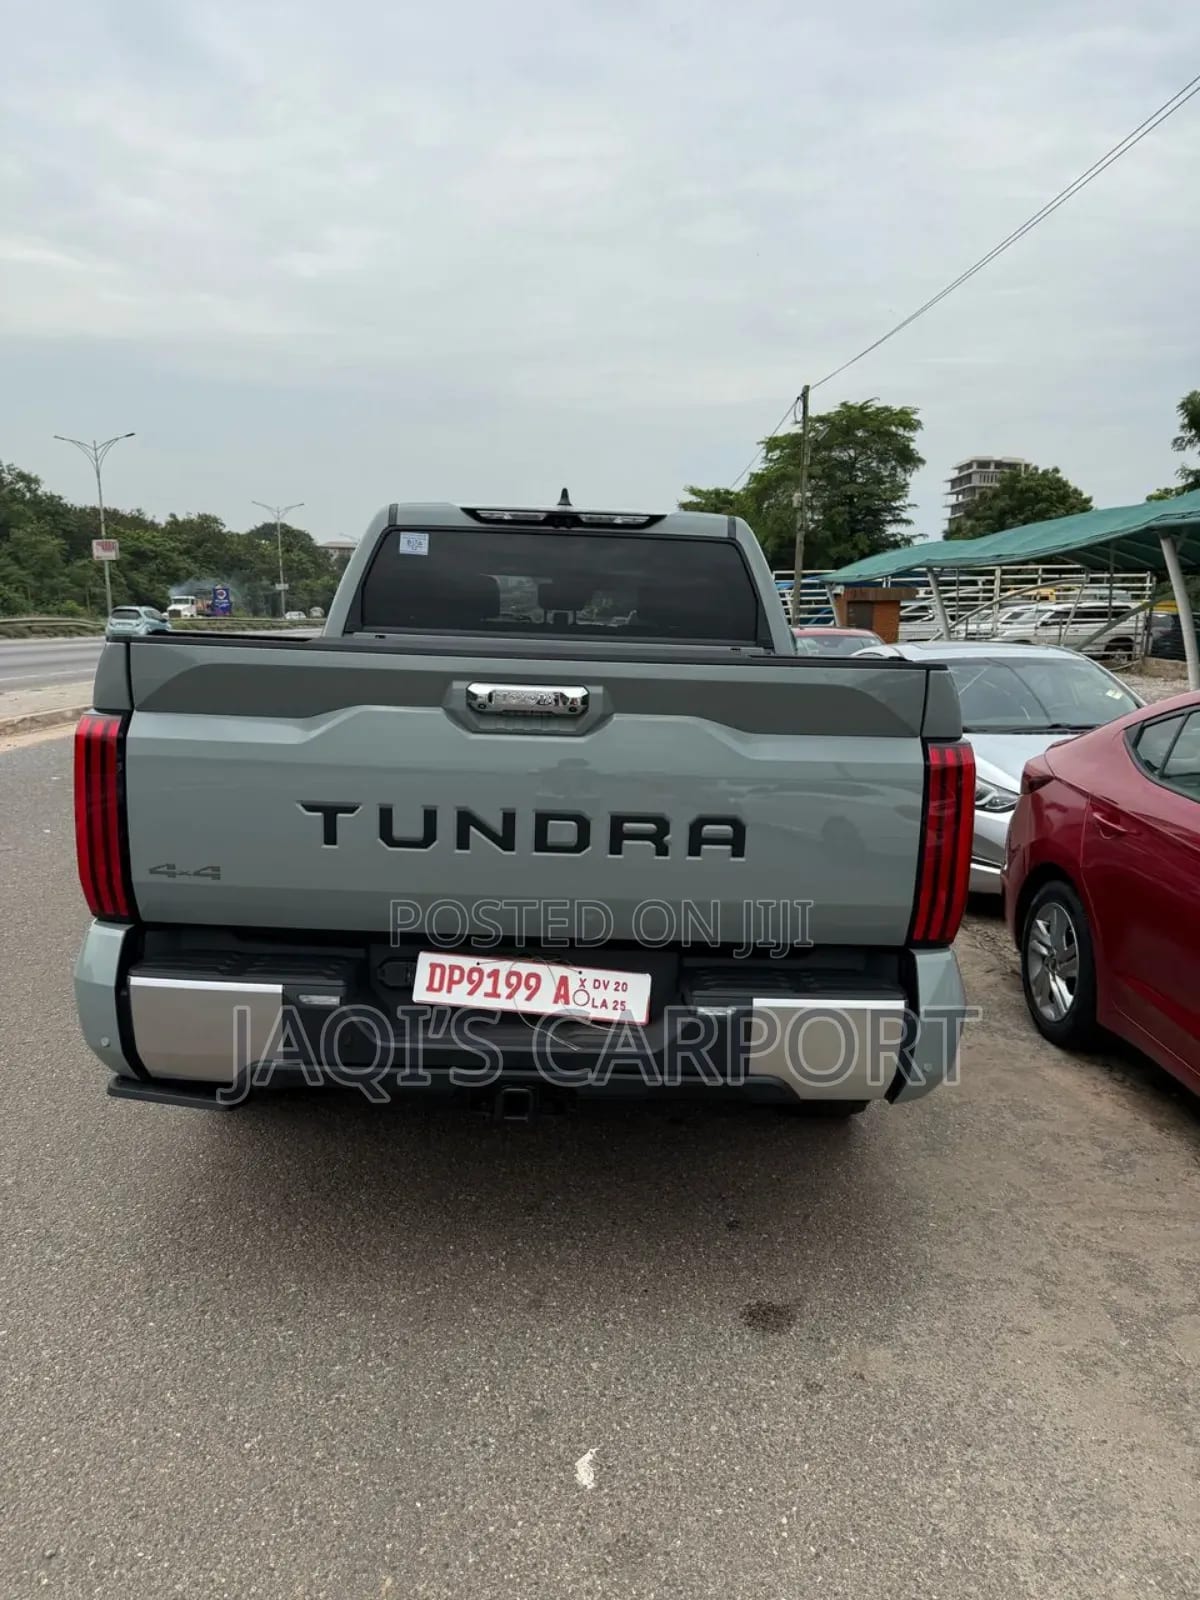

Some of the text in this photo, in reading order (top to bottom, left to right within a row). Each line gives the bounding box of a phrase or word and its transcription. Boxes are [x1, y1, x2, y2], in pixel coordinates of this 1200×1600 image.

[296, 800, 746, 861] TUNDRA
[425, 962, 570, 1006] DP9199 A
[593, 978, 628, 993] DV 20
[591, 997, 626, 1012] LA 25
